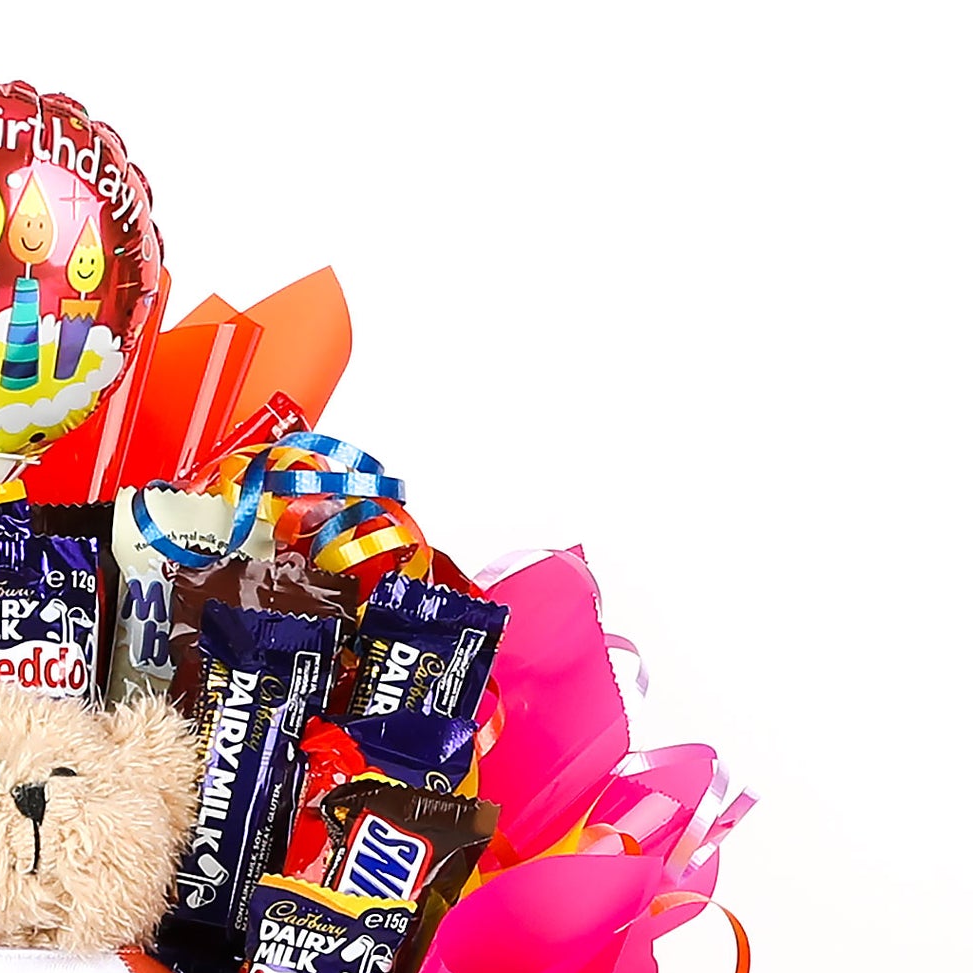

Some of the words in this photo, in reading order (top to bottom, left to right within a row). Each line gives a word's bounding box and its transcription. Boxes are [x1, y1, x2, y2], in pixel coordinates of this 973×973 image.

[71, 570, 96, 593] 12g
[363, 641, 420, 716] DAIR
[215, 669, 260, 770] DAIRY
[192, 769, 239, 854] MILK
[259, 918, 348, 954] DAIRY
[265, 900, 348, 938] Cadbury
[383, 913, 409, 934] 15g
[253, 942, 319, 973] MILK
